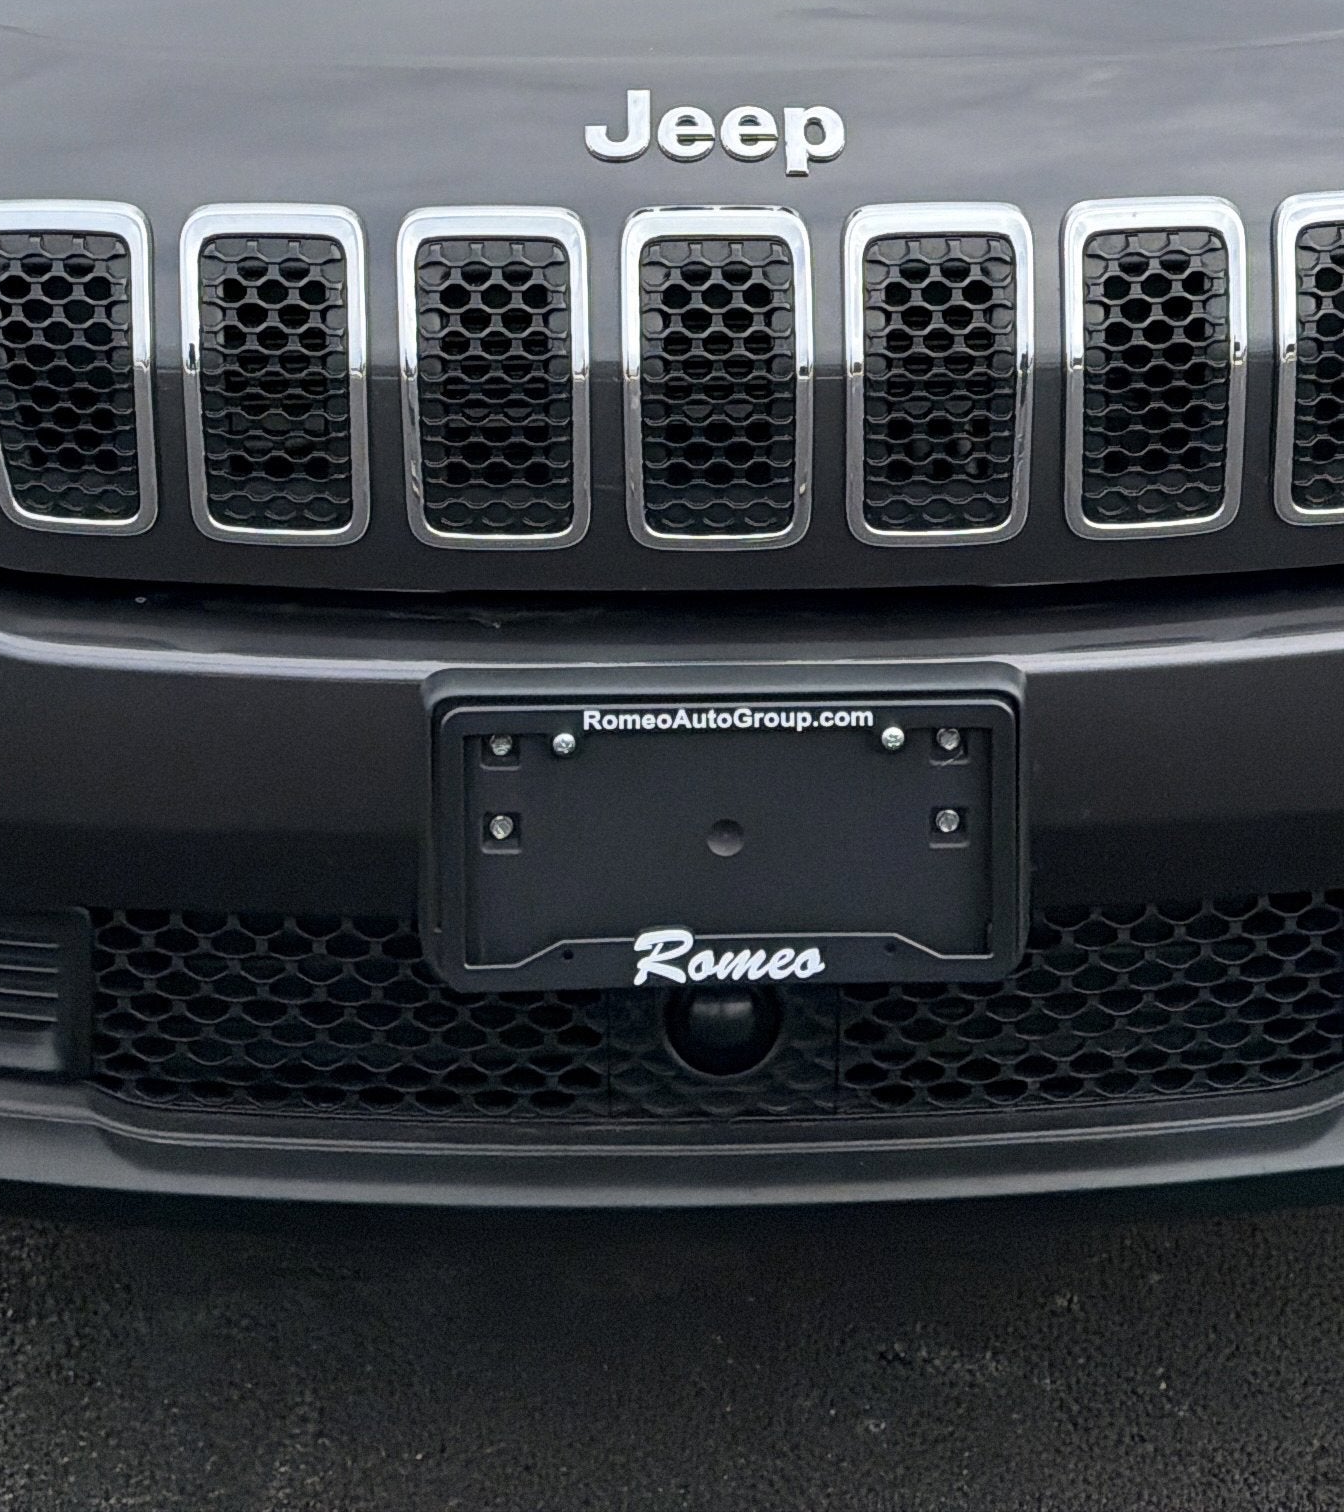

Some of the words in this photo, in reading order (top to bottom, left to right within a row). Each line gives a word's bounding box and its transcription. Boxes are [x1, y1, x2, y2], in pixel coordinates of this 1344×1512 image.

[585, 89, 846, 177] Jeep
[583, 708, 874, 732] RomeoAutoGroup.com
[633, 928, 825, 986] Romeo
